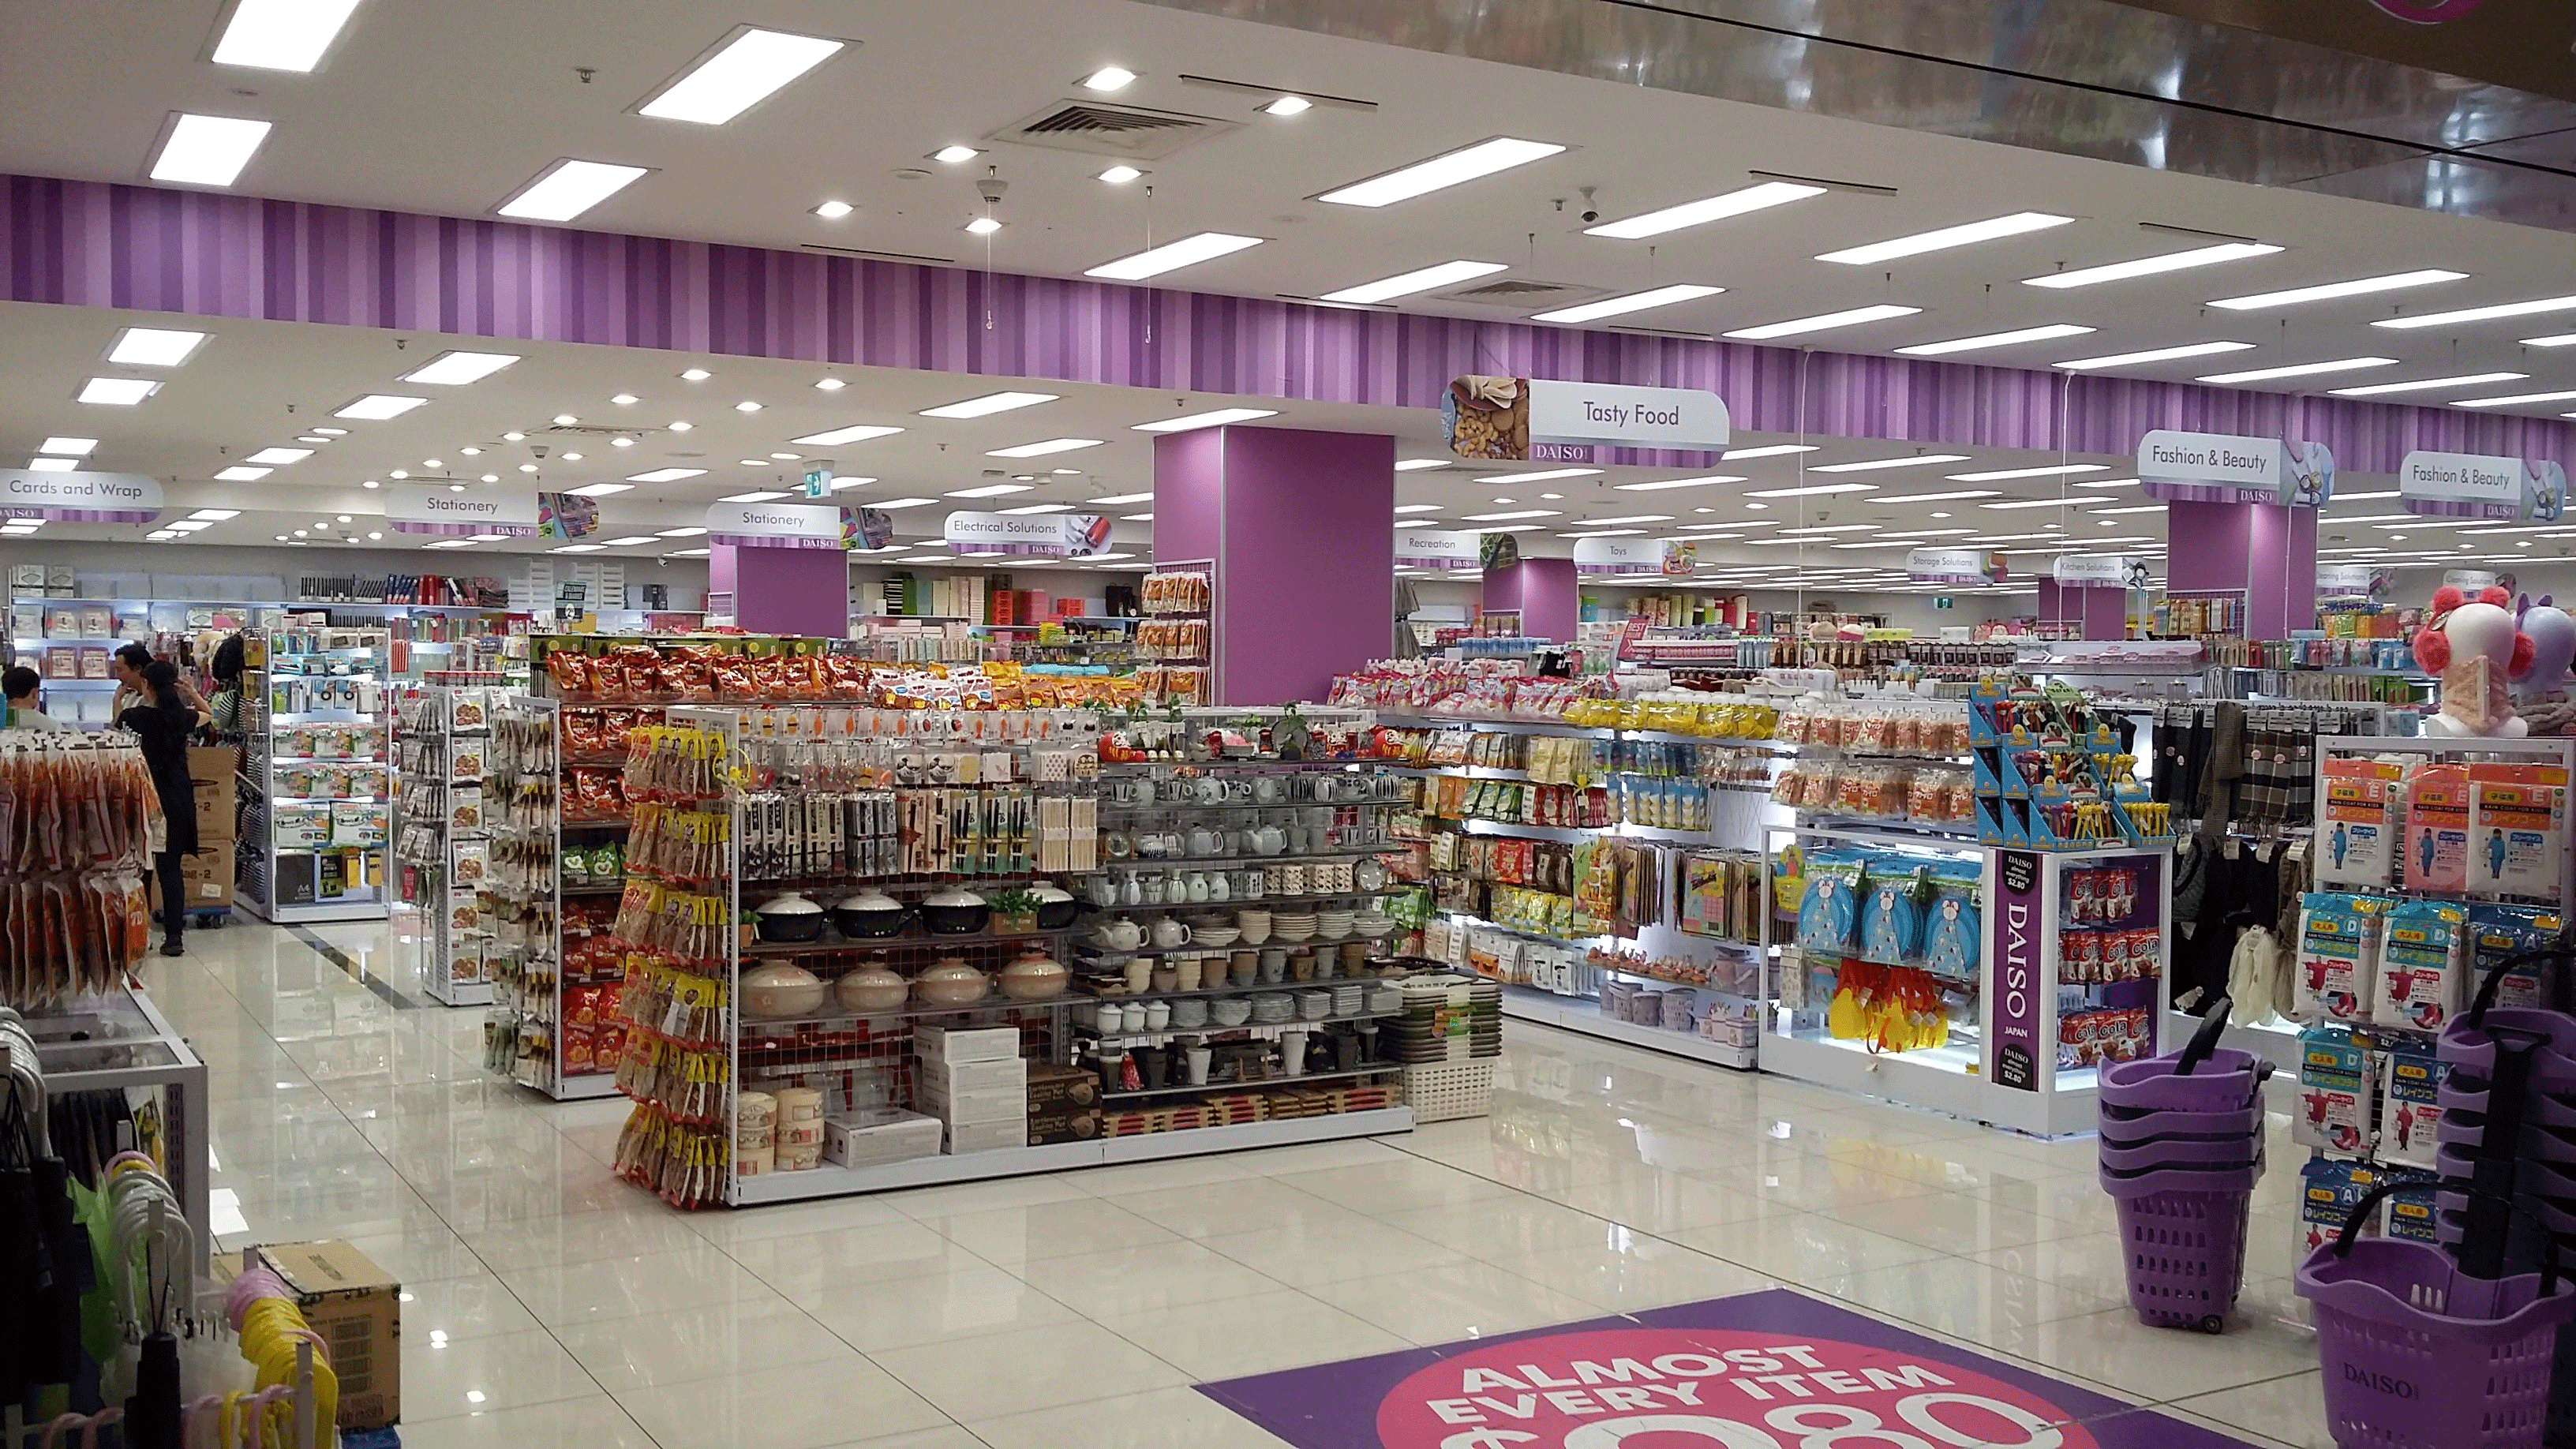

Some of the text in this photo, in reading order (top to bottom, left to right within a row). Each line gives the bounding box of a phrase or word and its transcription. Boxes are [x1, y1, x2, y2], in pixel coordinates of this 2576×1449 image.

[1583, 401, 1679, 428] Tasty Food
[1537, 445, 1583, 460] DAISO
[2153, 445, 2267, 474] Fashion & Beauty
[2413, 465, 2510, 489] Fashion & Beauty
[9, 480, 142, 499] Cards and Wrap
[2240, 490, 2273, 502] DAISO
[427, 497, 499, 514] Stationery
[2488, 506, 2514, 516] DAISO
[0, 508, 34, 519] AISO
[743, 512, 804, 527] Stationery
[496, 526, 531, 537] DAISO
[954, 520, 1057, 534] Electrical Solutions
[803, 539, 833, 548] DAISO
[1409, 537, 1455, 549] Recreation
[1609, 545, 1627, 557] Toys
[1913, 556, 1973, 567] Storage Solutions
[2061, 563, 2115, 571] Kitchen Solutions
[1627, 623, 1645, 631] BEST
[2369, 784, 2379, 798] E
[2457, 790, 2468, 802] E
[2532, 789, 2544, 803] E
[2008, 856, 2032, 870] DAISO
[2005, 871, 2030, 884] everything
[2007, 878, 2025, 889] $2.80
[2347, 919, 2357, 933] D
[2433, 928, 2446, 942] D
[2524, 934, 2536, 947] A
[2107, 943, 2127, 960] Cola
[2132, 938, 2159, 955] Cola
[2006, 902, 2028, 1019] DAISO
[2004, 1026, 2028, 1039] JAPAN
[2075, 1024, 2097, 1041] Cola
[2099, 1020, 2128, 1038] Cola
[2005, 1047, 2029, 1064] DAISO
[2347, 1053, 2357, 1066] D
[2002, 1062, 2027, 1078] everything
[2004, 1070, 2022, 1084] $2.80
[2436, 1065, 2446, 1077] A
[2342, 1188, 2353, 1202] A
[1462, 1345, 1826, 1393] ALMOST
[2344, 1362, 2413, 1398] DAISO
[1426, 1364, 1956, 1424] EVERY ITEM
